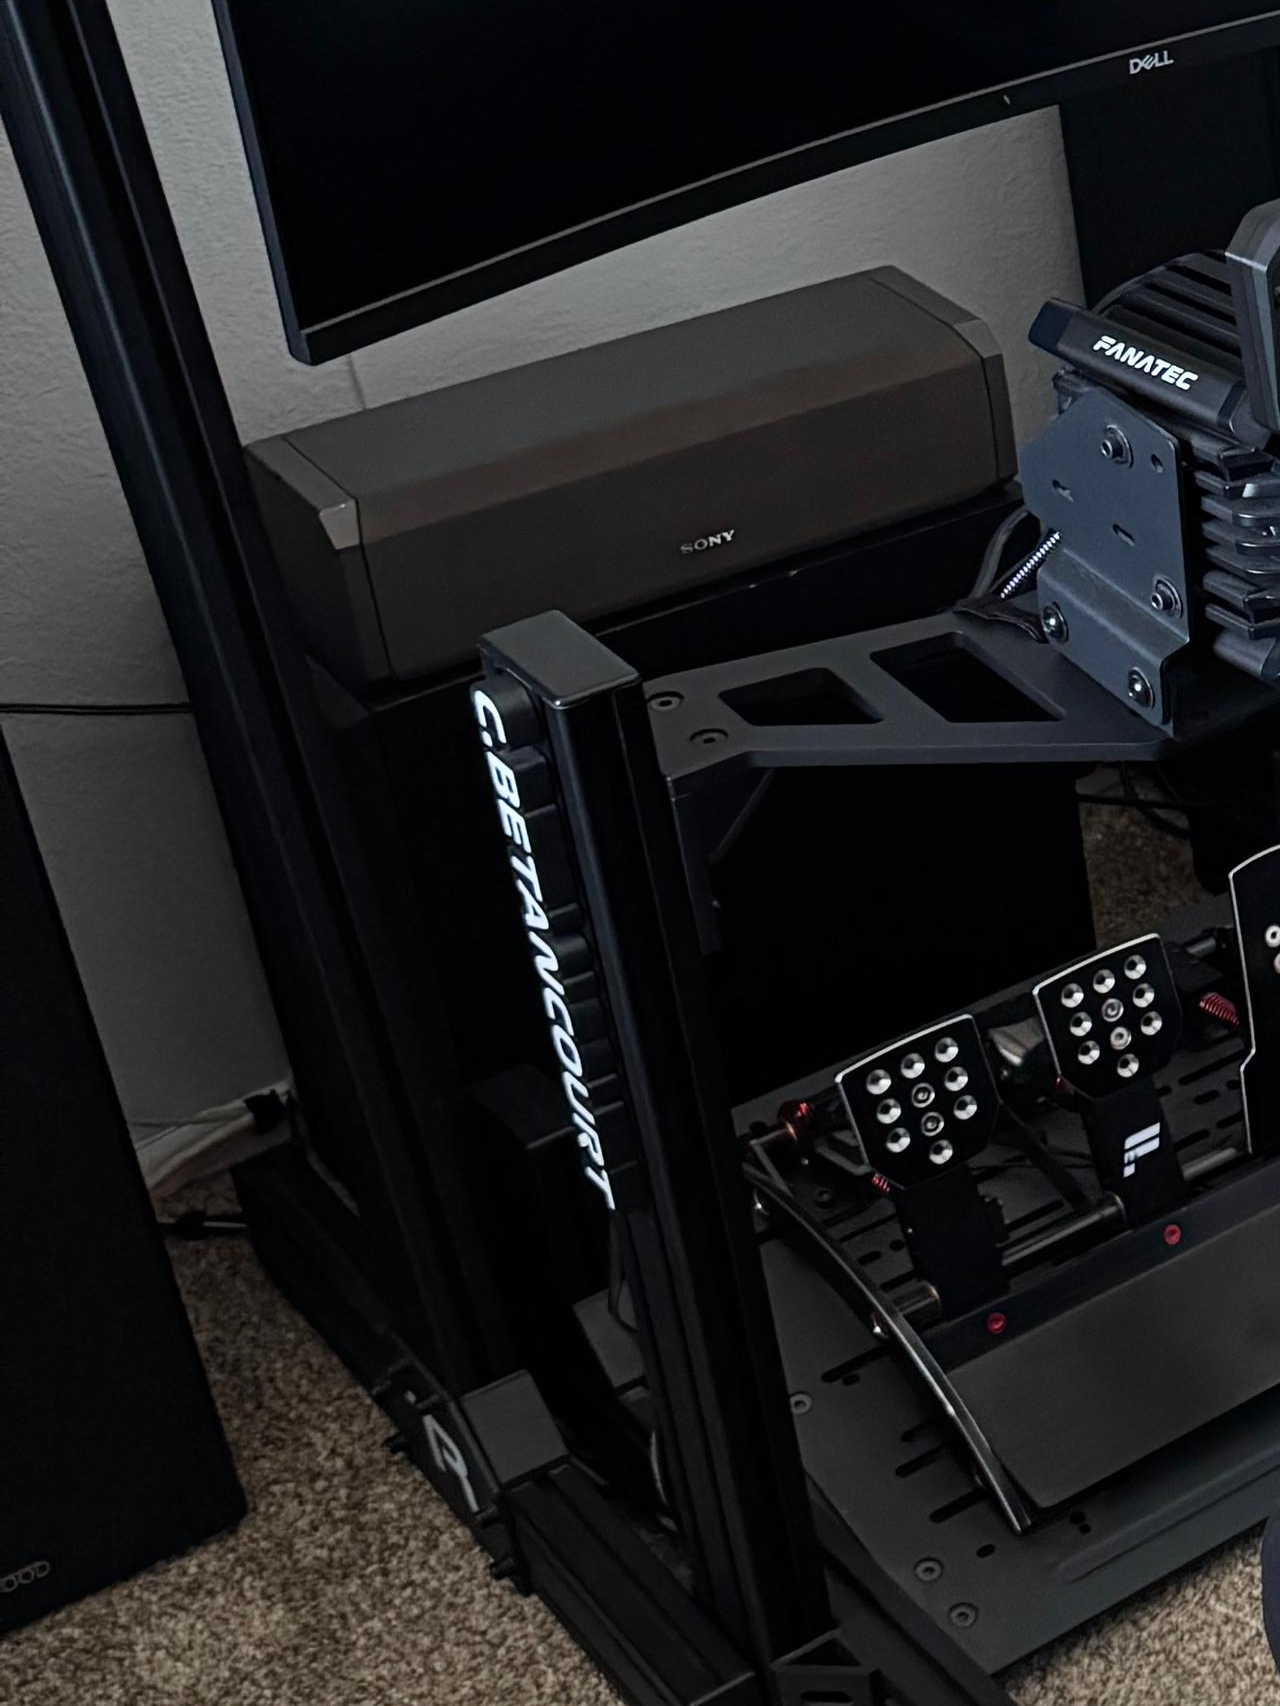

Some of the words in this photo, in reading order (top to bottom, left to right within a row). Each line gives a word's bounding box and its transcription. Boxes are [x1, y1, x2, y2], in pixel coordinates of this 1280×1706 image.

[1129, 50, 1175, 74] DELL
[1093, 335, 1199, 391] FANATEC
[680, 529, 735, 554] SONY
